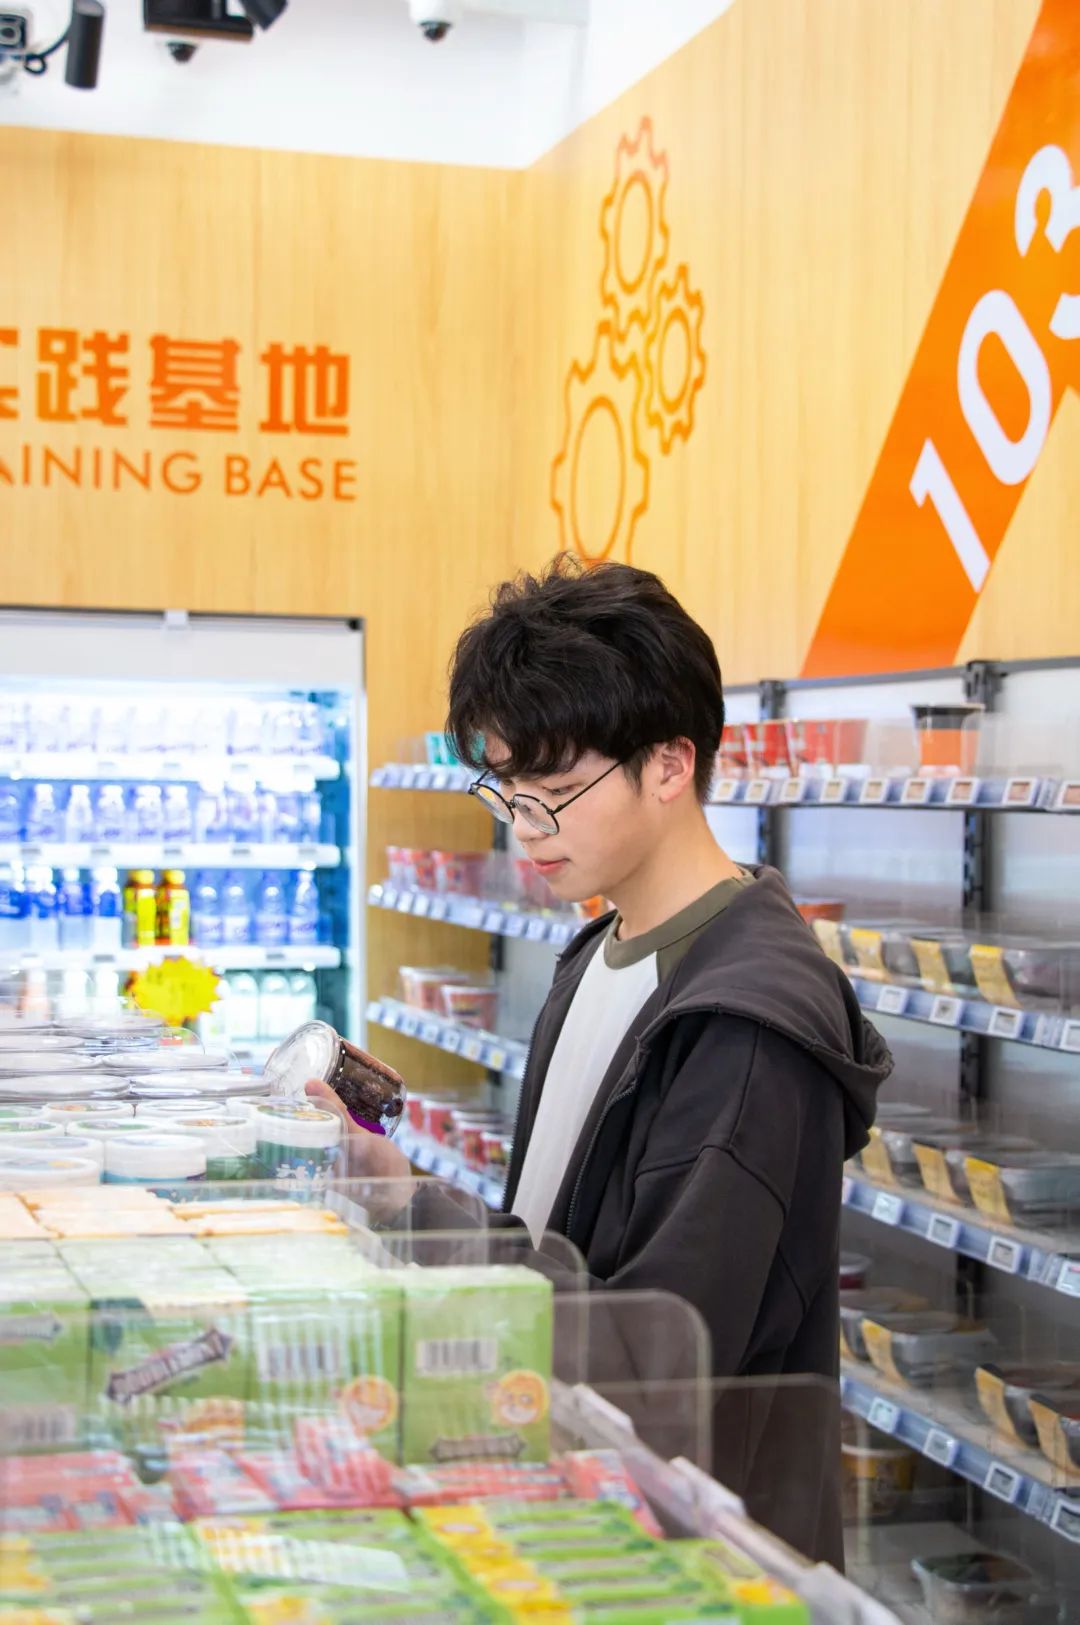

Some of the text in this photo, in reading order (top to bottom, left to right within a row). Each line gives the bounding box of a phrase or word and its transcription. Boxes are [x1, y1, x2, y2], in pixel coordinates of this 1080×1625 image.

[0, 327, 351, 437] 践基地
[909, 144, 1080, 592] 103
[223, 453, 358, 502] BASE
